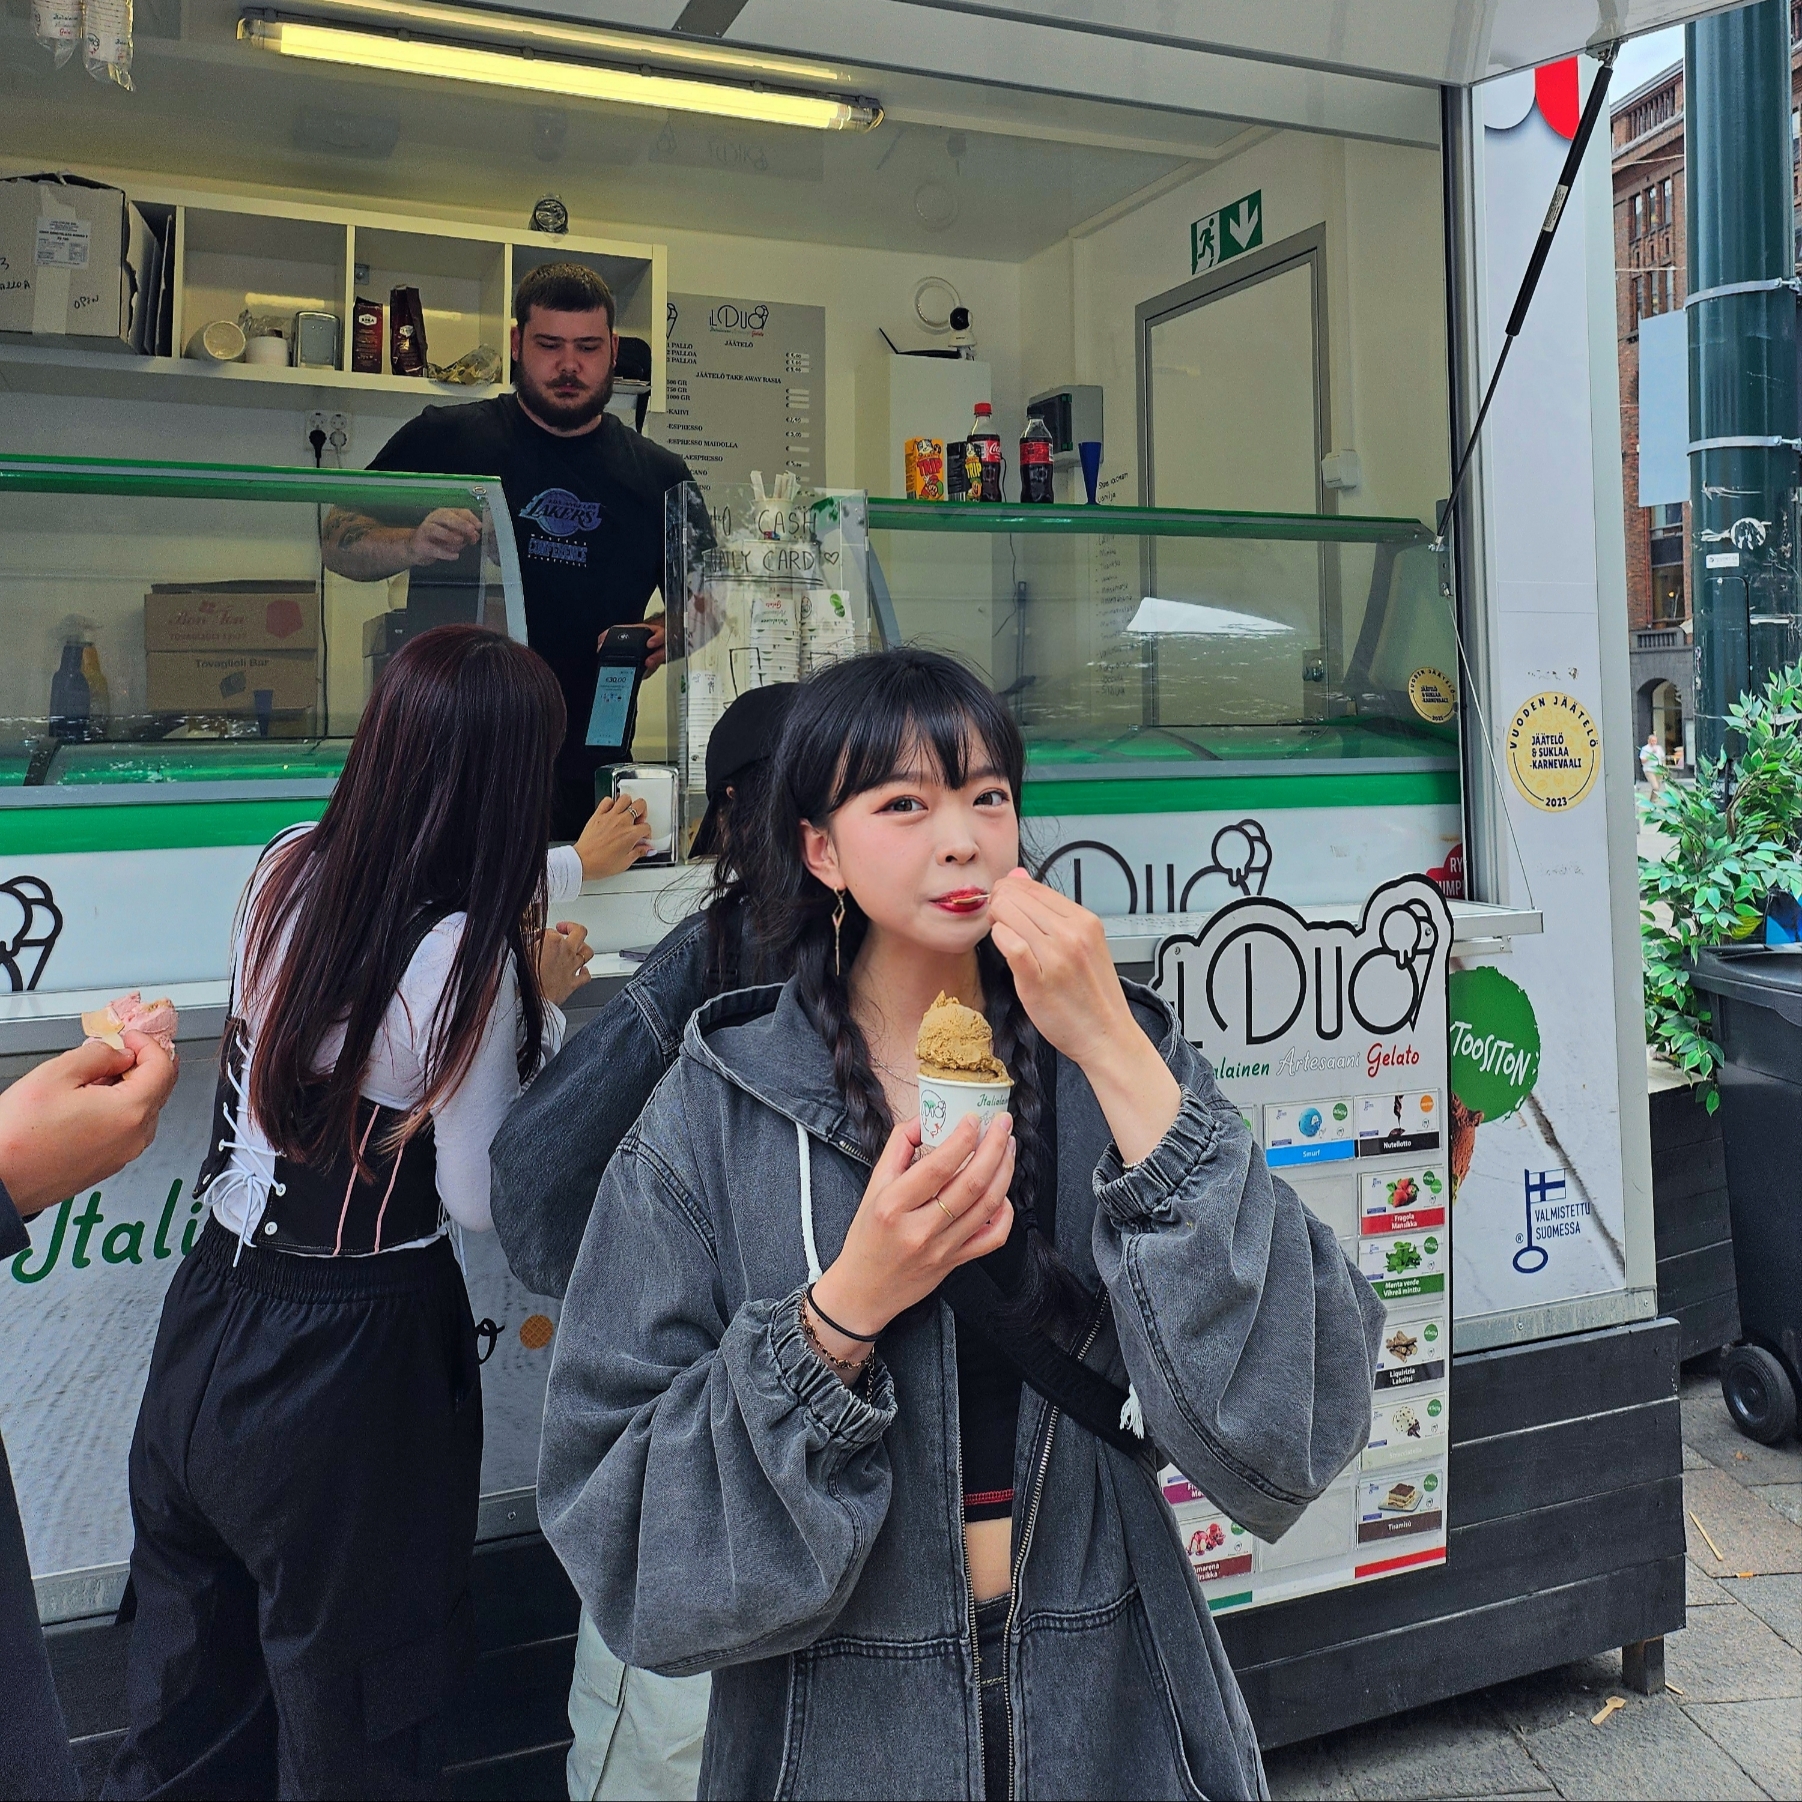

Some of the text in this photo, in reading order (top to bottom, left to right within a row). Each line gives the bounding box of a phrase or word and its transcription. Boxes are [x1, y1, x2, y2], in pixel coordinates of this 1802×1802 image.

[672, 357, 697, 365] PALLOA
[696, 371, 725, 380] JÄÄTELÖ
[726, 373, 744, 381] TAKE
[745, 375, 762, 383] AWAY
[704, 440, 738, 449] MAIDOLLA
[684, 454, 723, 462] AESPRESSO
[917, 458, 943, 476] TRIP
[965, 461, 982, 479] TRIP
[526, 498, 596, 528] LAKERS
[758, 509, 816, 536] CASH
[763, 551, 815, 571] CARD
[196, 658, 269, 668] Tovaglioli Bar
[1509, 695, 1599, 749] VUODEN JÄÄTELÖ
[1531, 732, 1564, 745] JÄÄTELÖ
[1532, 747, 1569, 757] & SUKLAA
[1530, 758, 1582, 770] -KARNEVAALI
[1545, 796, 1568, 807] 2023
[1212, 1042, 1420, 1081] alainen Artesaani Gelato
[1302, 1149, 1321, 1158] Smurf
[1394, 1213, 1415, 1223] Fragola
[1534, 1202, 1591, 1223] VALMISTETTU
[11, 1178, 203, 1284] Itali
[1391, 1221, 1418, 1230] Mansikka
[1536, 1223, 1581, 1240] SUOMESSA
[1385, 1281, 1402, 1289] Menta
